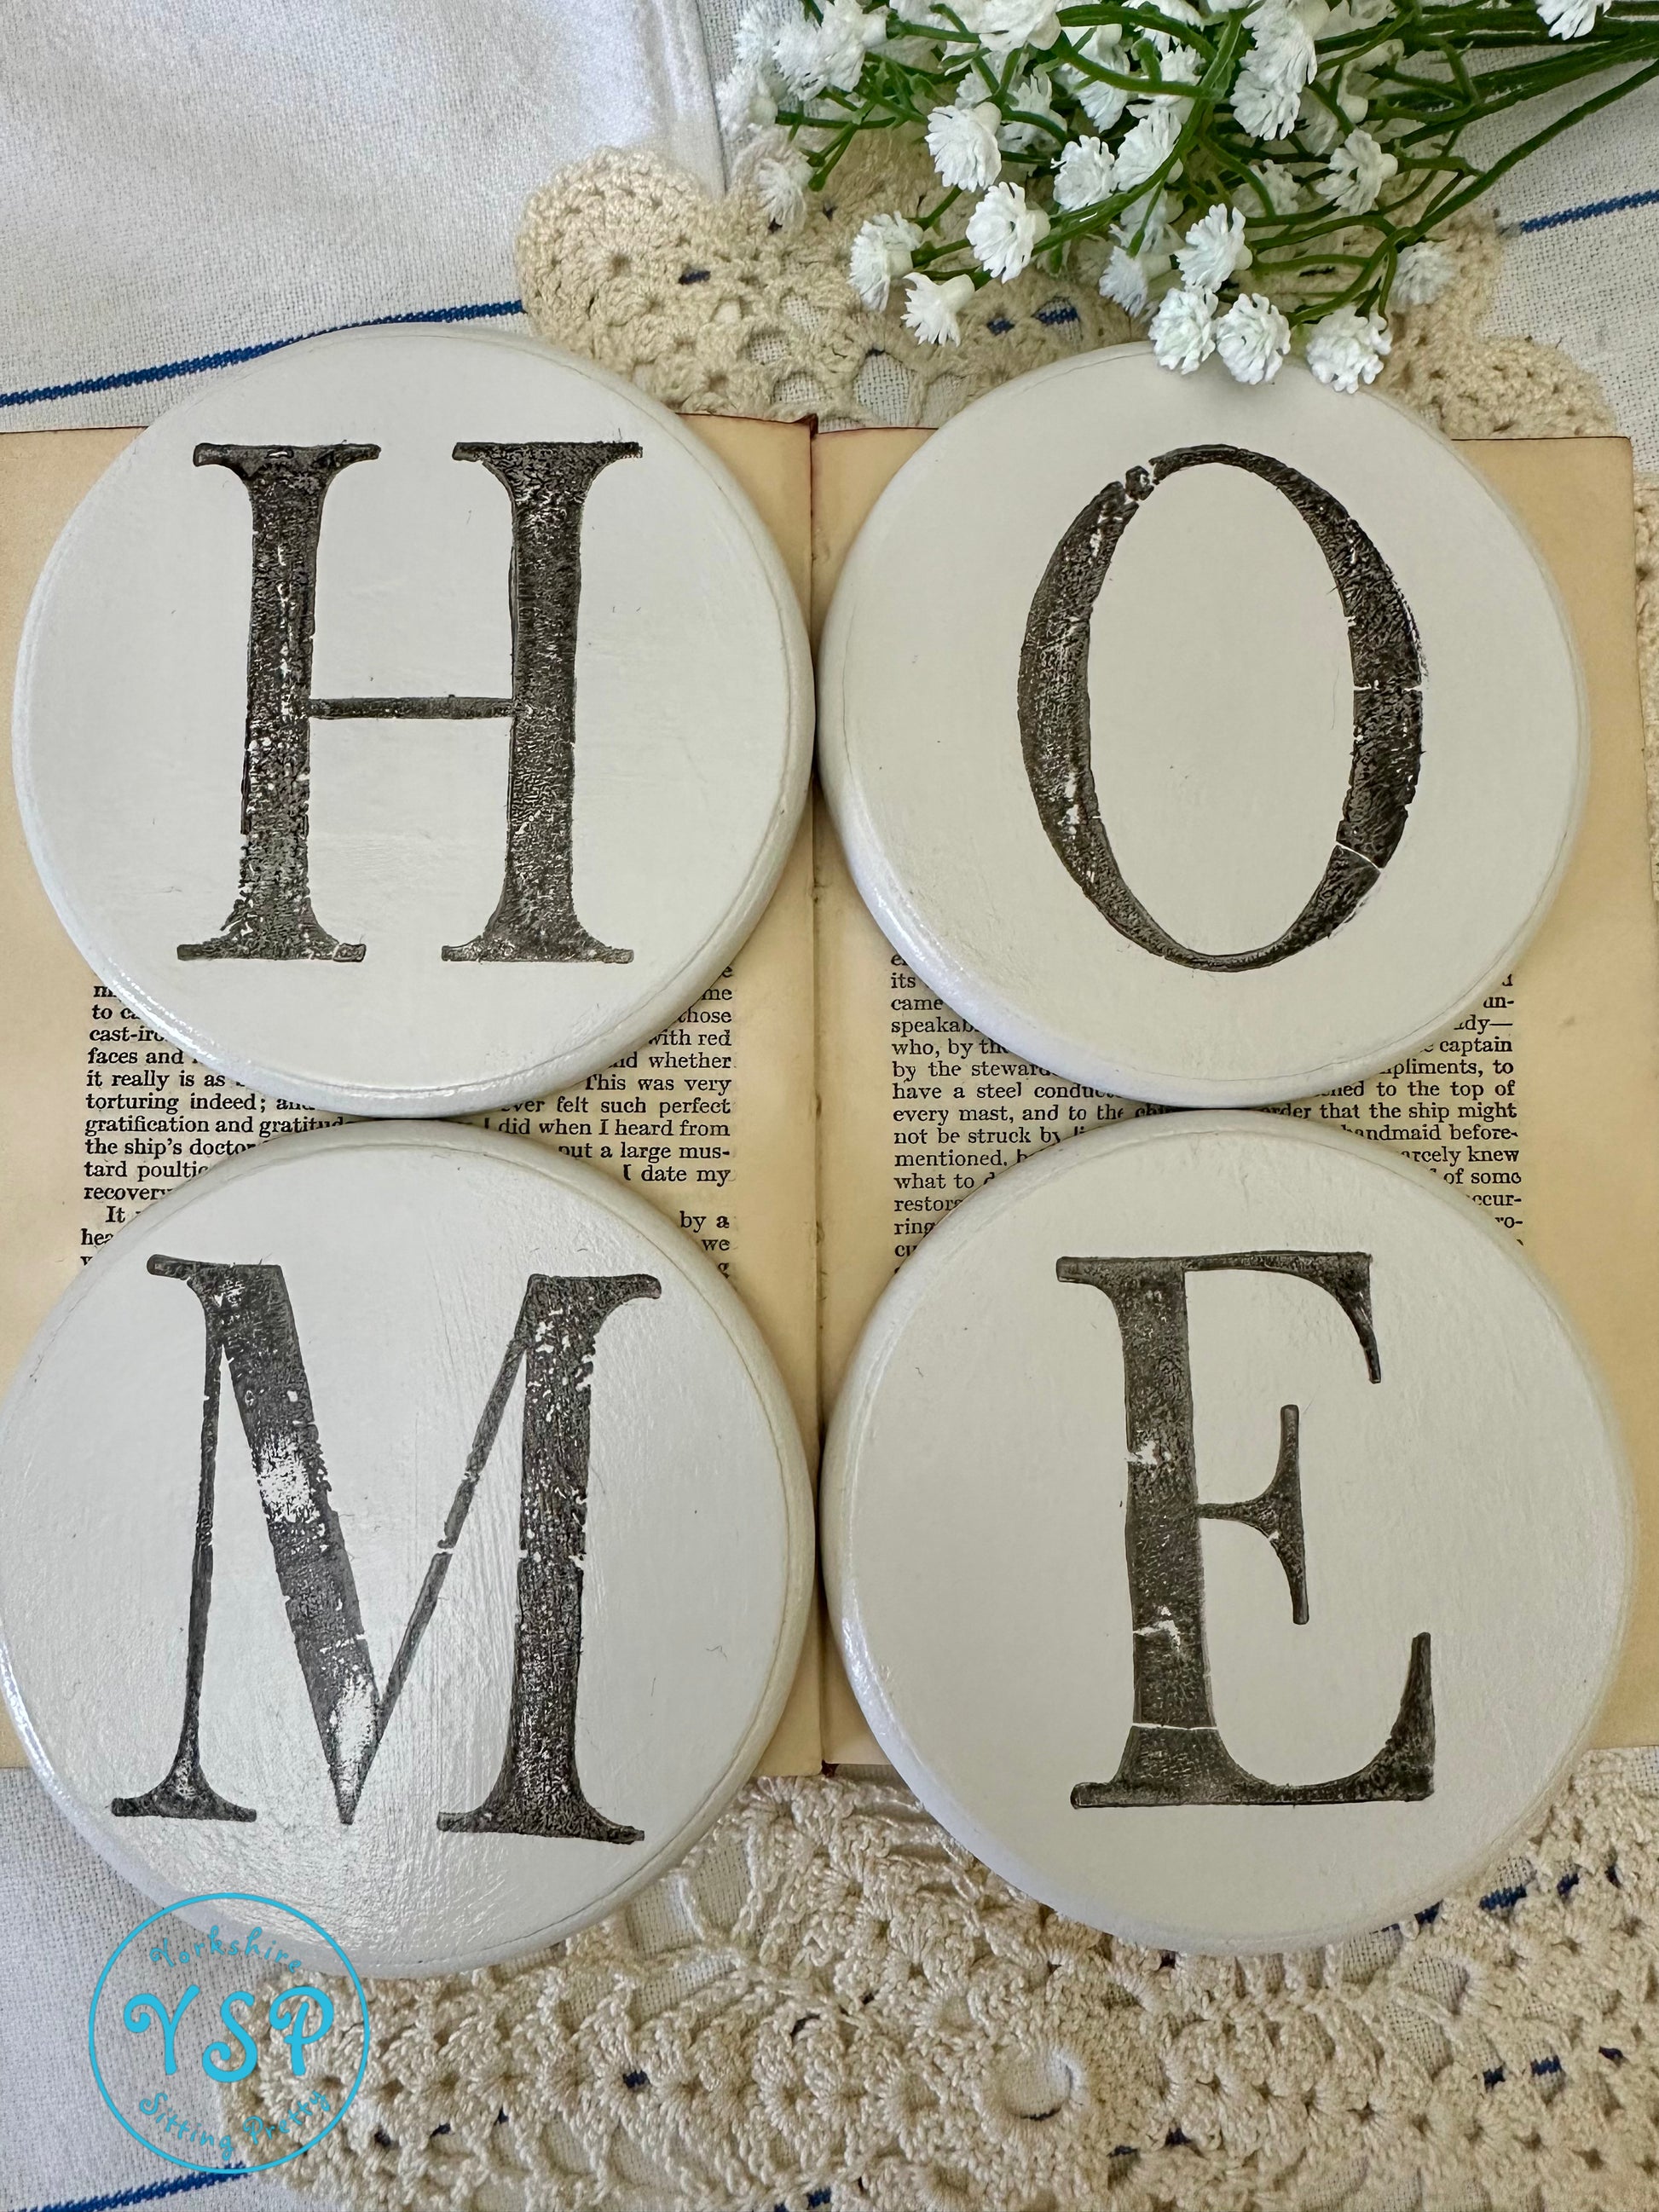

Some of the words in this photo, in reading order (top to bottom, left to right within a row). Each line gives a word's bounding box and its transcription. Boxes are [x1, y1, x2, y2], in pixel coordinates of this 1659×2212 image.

[176, 441, 643, 963] H
[1018, 444, 1423, 972] O
[891, 973, 916, 989] its
[92, 1004, 113, 1019] to
[891, 998, 944, 1010] came
[697, 1029, 732, 1046] red
[892, 1038, 939, 1058] who,
[948, 1038, 974, 1059] by
[1440, 1037, 1512, 1057] captain
[88, 1047, 138, 1064] faces
[146, 1047, 184, 1064] and
[649, 1051, 731, 1069] whether
[893, 1062, 916, 1082] by
[928, 1062, 962, 1077] the
[1493, 1060, 1514, 1074] to
[86, 1070, 102, 1087] it
[112, 1070, 170, 1091] really
[179, 1070, 194, 1087] is
[204, 1075, 226, 1087] as
[638, 1078, 674, 1091] was
[684, 1079, 732, 1096] very
[893, 1083, 942, 1099] have
[953, 1089, 965, 1099] a
[976, 1083, 1022, 1099] steel
[1376, 1082, 1397, 1097] to
[1408, 1081, 1440, 1097] the
[1450, 1083, 1484, 1100] top
[1494, 1080, 1516, 1097] of
[85, 1095, 179, 1115] torturing
[557, 1096, 589, 1113] felt
[600, 1096, 647, 1113] such
[659, 1096, 731, 1118] perfect
[893, 1112, 949, 1125] every
[959, 1106, 1014, 1123] mast,
[1022, 1105, 1059, 1121] and
[1068, 1106, 1087, 1121] to
[1321, 1103, 1361, 1119] that
[1369, 1102, 1402, 1119] the
[1408, 1102, 1449, 1123] ship
[1458, 1102, 1517, 1123] might
[85, 1117, 210, 1137] gratification
[215, 1117, 253, 1133] and
[499, 1118, 530, 1135] did
[539, 1118, 592, 1135] when
[598, 1119, 610, 1135] I
[615, 1118, 674, 1136] heard
[679, 1118, 731, 1136] from
[894, 1129, 928, 1145] not
[938, 1128, 960, 1144] be
[968, 1127, 1032, 1144] struck
[1450, 1123, 1519, 1141] before-
[85, 1138, 118, 1155] the
[124, 1138, 182, 1159] ship's
[600, 1146, 613, 1158] a
[620, 1142, 671, 1163] large
[679, 1146, 730, 1158] mus-
[1466, 1146, 1519, 1162] knew
[84, 1161, 127, 1177] tard
[641, 1165, 687, 1181] date
[697, 1170, 731, 1187] my
[893, 1173, 946, 1189] what
[954, 1174, 974, 1189] to
[1443, 1168, 1465, 1184] of
[105, 1205, 125, 1223] It
[679, 1210, 707, 1233] by
[716, 1216, 730, 1228] a
[1056, 1251, 1436, 1809] E
[111, 1254, 662, 1845] M
